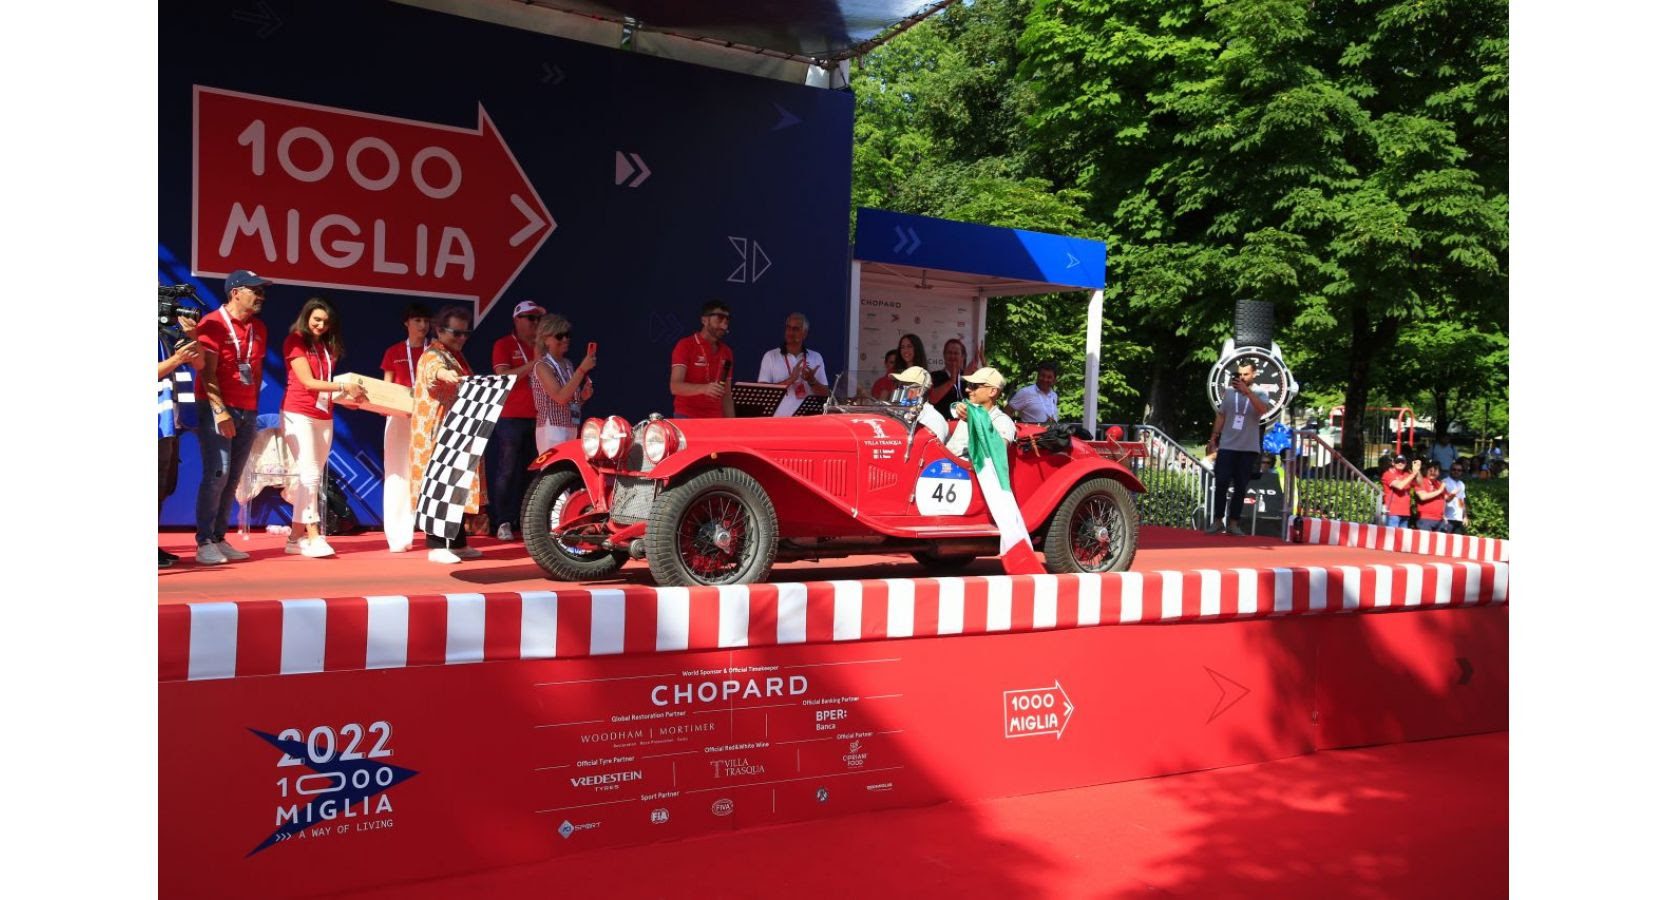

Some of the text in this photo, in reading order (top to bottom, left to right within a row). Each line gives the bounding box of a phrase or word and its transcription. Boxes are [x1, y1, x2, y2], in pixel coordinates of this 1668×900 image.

[237, 119, 462, 199] 1000
[218, 202, 475, 281] MIGLIA
[860, 298, 902, 308] CHOPARD
[931, 483, 957, 503] 46
[651, 675, 808, 706] CHOPARD
[803, 698, 820, 706] Official
[1011, 693, 1055, 711] 1000
[631, 712, 664, 721] Restoration
[1009, 713, 1058, 732] MIGLIA
[581, 729, 643, 743] WOODHAM
[660, 723, 715, 735] MORTIMER
[816, 723, 836, 731] Banca
[277, 720, 394, 767] 2022
[599, 758, 612, 766] Tyre
[724, 758, 749, 768] VILLA
[570, 770, 643, 787] VREDESTEIN
[725, 765, 765, 777] TRASQUA
[276, 767, 393, 797] 1000
[641, 791, 679, 801] Sport Partner
[275, 793, 393, 826] MIGLIA
[652, 810, 668, 821] FIA
[715, 803, 731, 811] FIVA
[299, 819, 393, 839] A WAY OF LIVING
